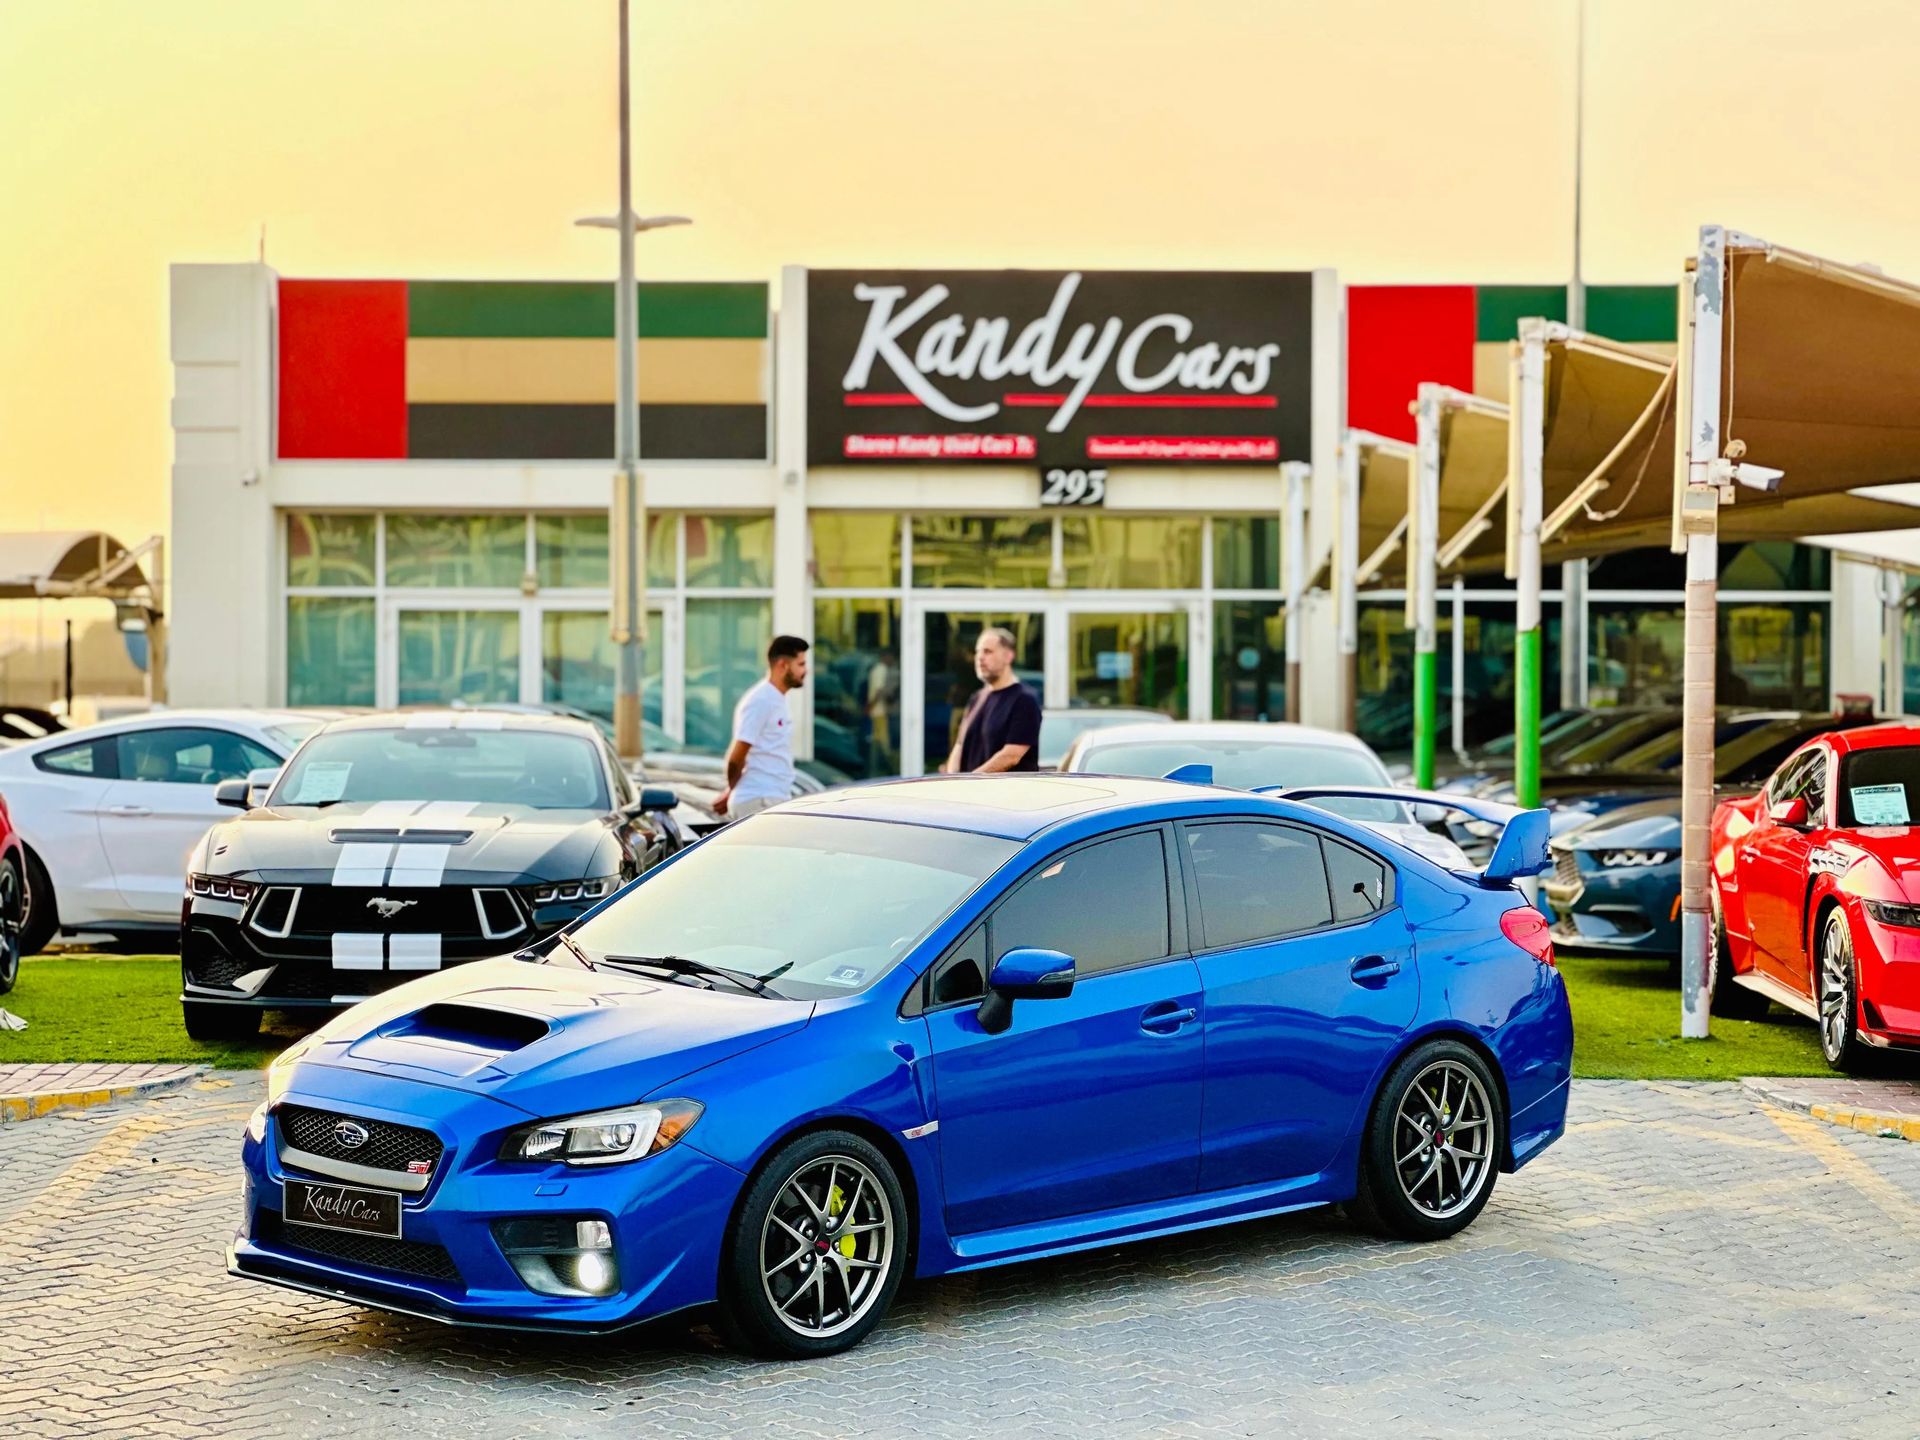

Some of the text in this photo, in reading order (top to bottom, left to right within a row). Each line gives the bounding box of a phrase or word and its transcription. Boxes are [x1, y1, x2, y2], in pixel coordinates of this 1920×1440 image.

[843, 272, 1280, 432] Kandy Cars
[1041, 469, 1108, 504] 295
[303, 1186, 381, 1222] Kandy Cars
